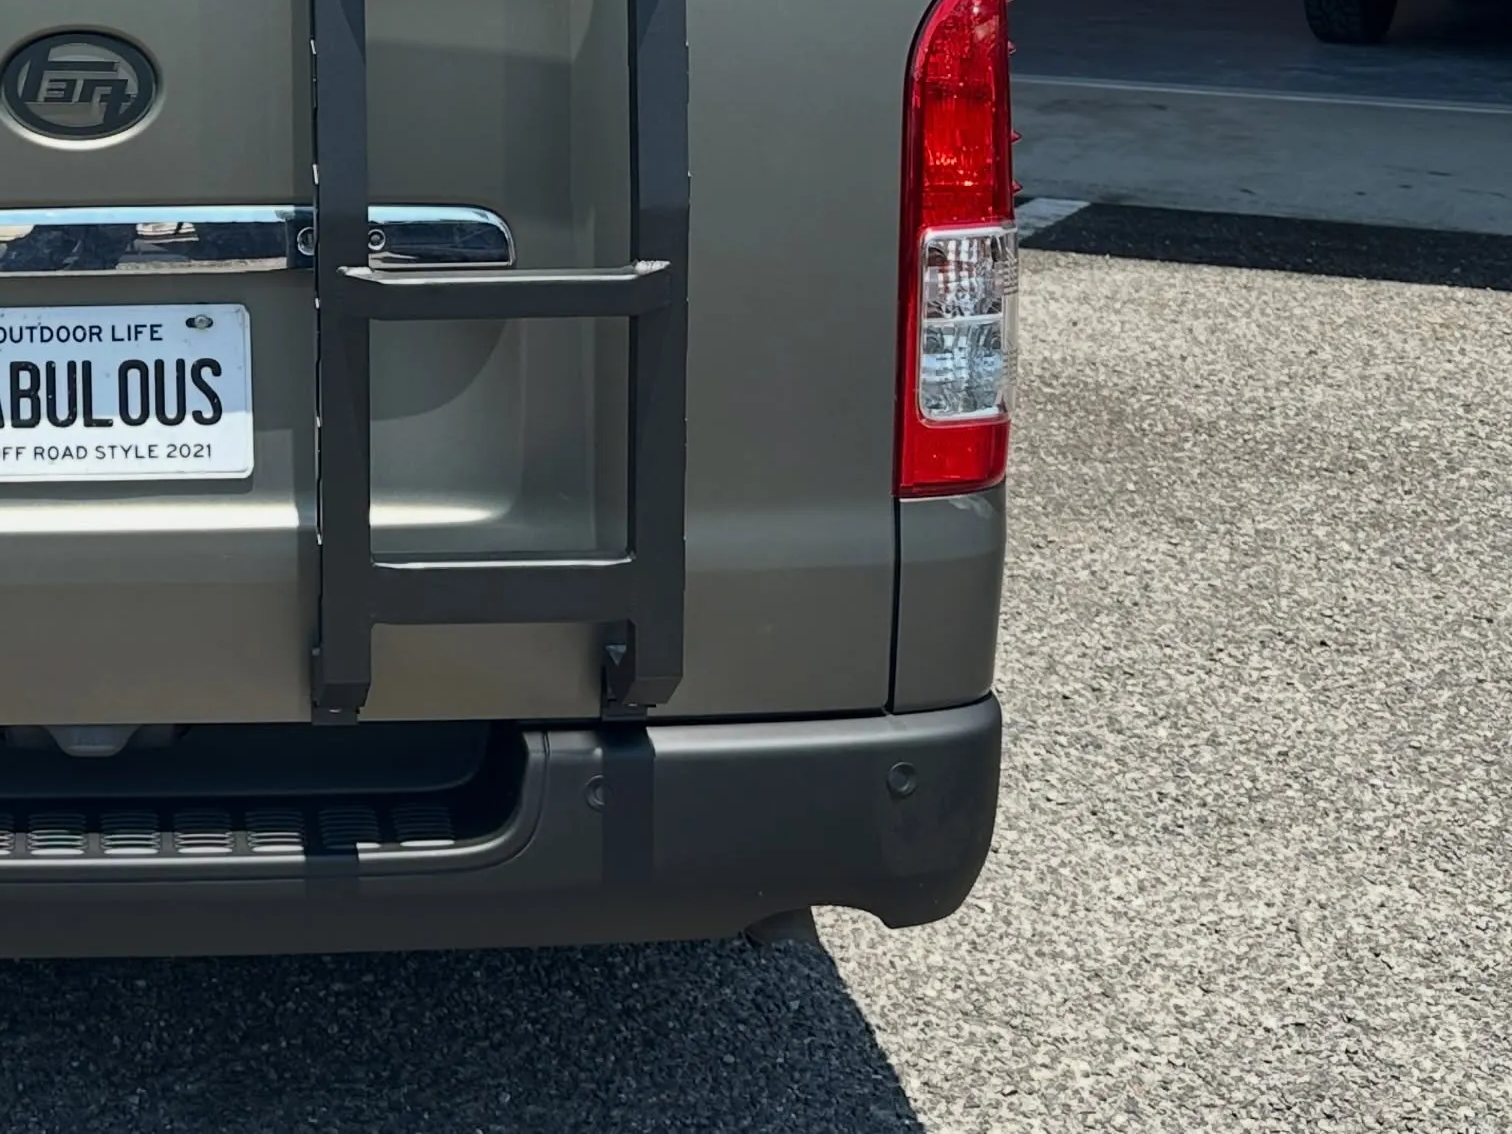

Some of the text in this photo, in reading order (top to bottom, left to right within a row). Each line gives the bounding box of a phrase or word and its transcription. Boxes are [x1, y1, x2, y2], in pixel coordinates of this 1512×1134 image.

[111, 324, 163, 342] LIFE
[33, 445, 88, 461] ROAD
[95, 444, 159, 460] STYLE
[166, 443, 212, 459] 2021
